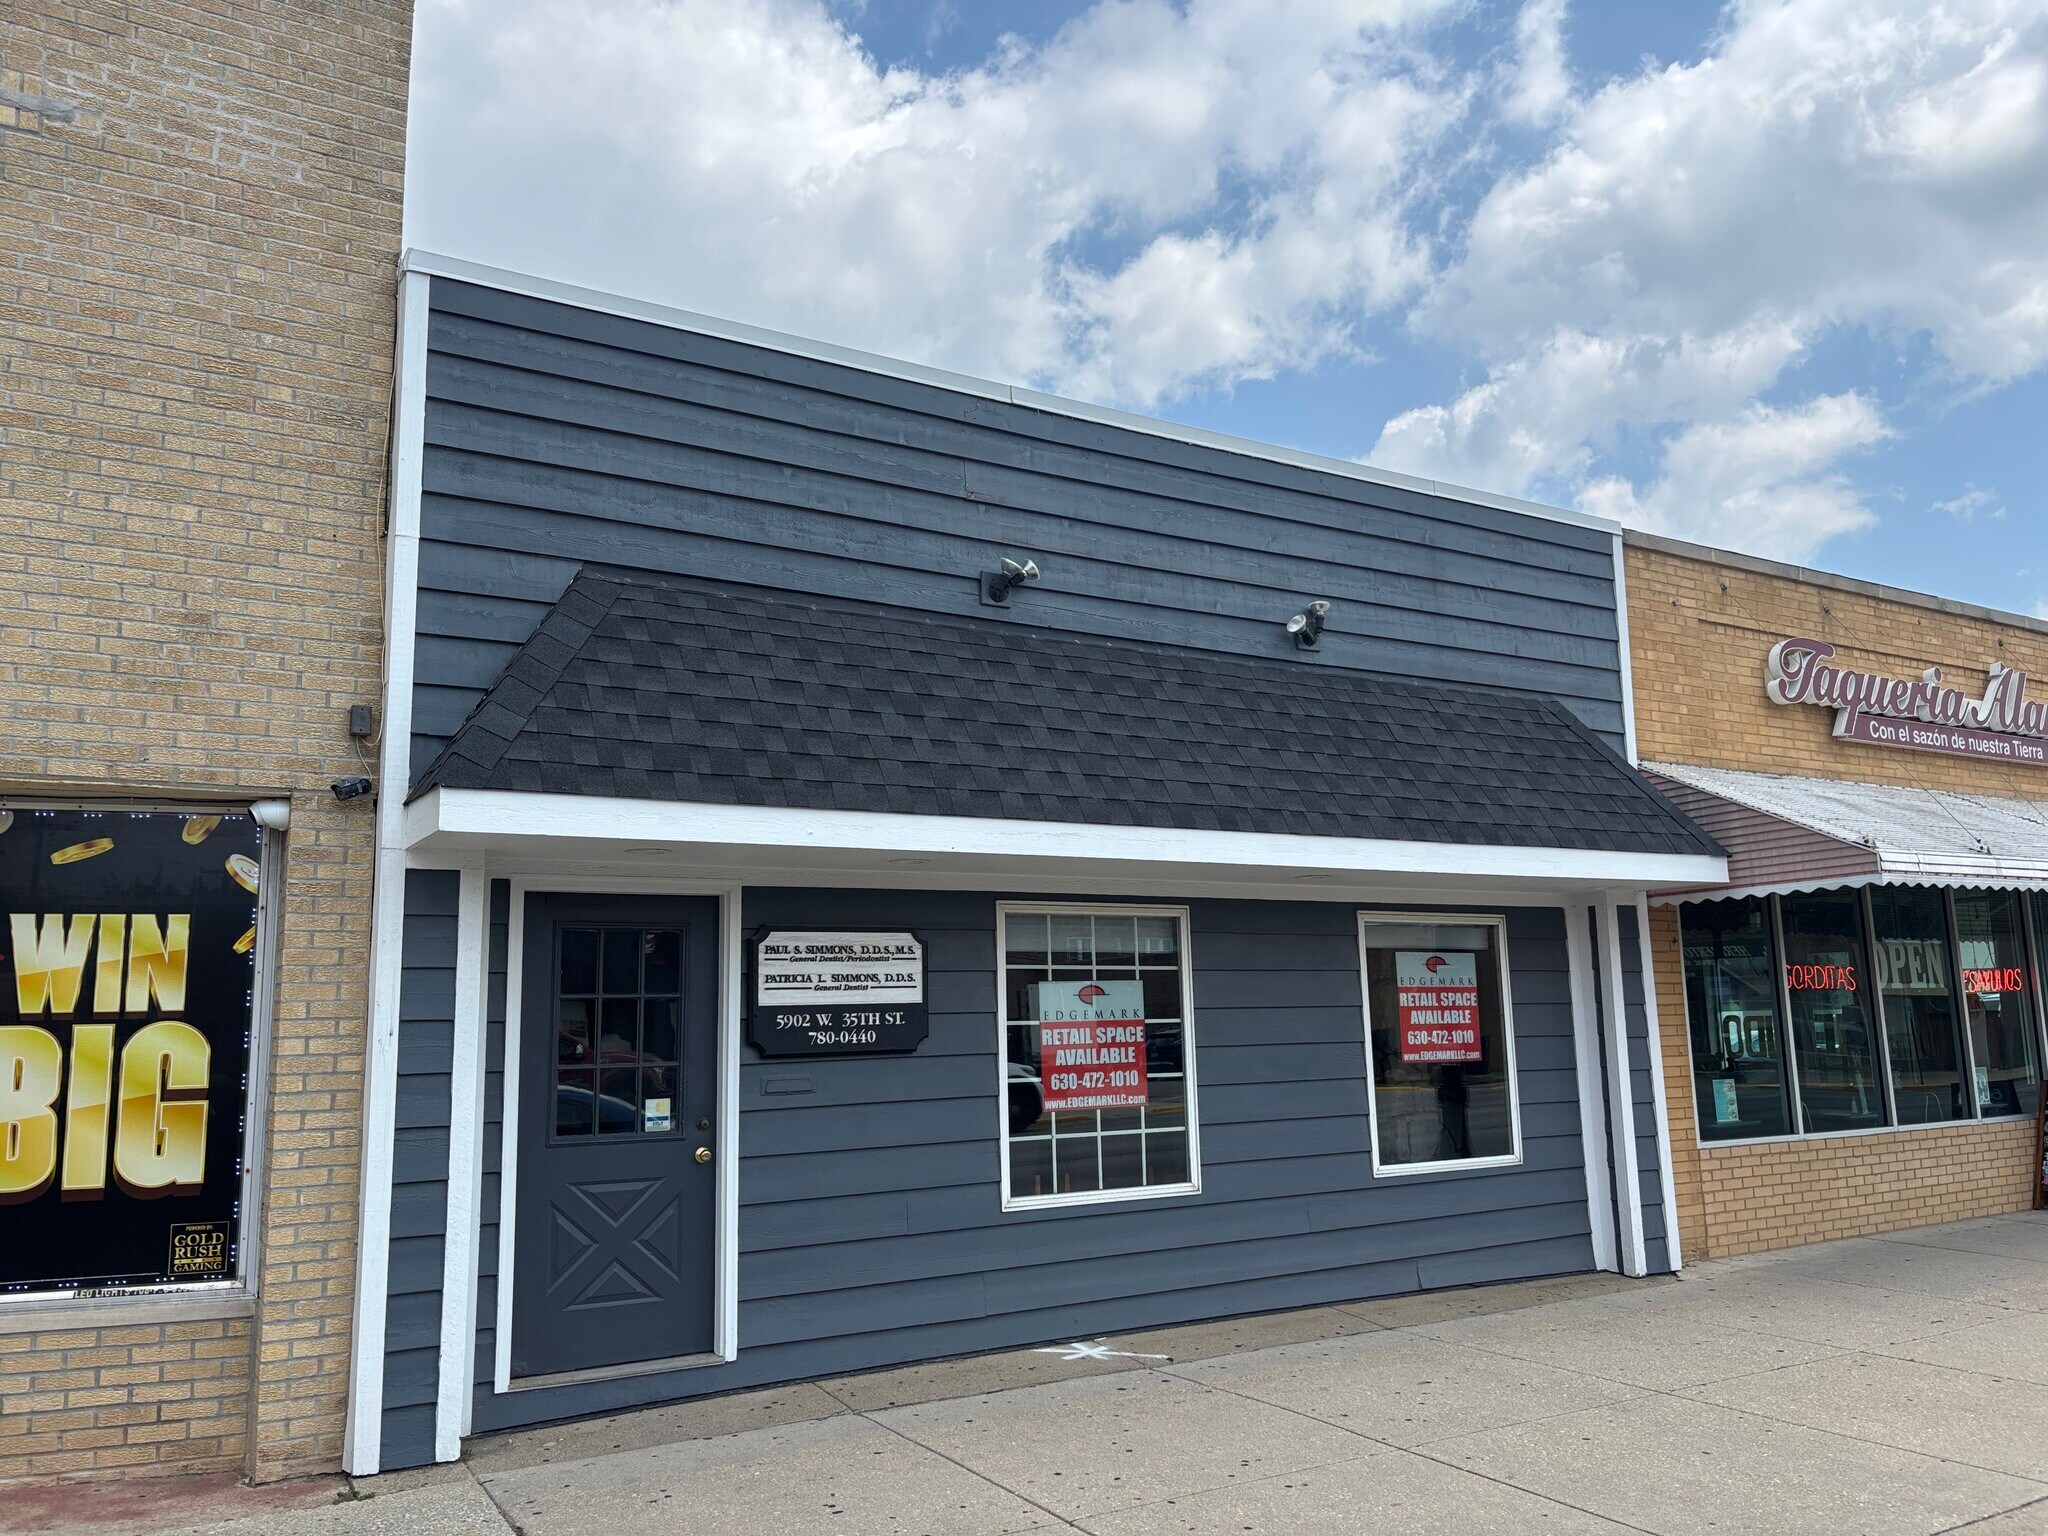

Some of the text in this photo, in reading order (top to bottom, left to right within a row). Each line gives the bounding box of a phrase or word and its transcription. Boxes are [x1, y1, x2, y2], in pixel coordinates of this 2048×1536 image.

[1768, 637, 2048, 737] Taqueria Ala
[1869, 720, 2044, 760] Con el sazón de nuestra Tierra
[764, 945, 791, 955] PAUL
[794, 945, 803, 955] S.
[805, 945, 857, 956] SIMMONS,
[9, 913, 191, 1017] WIN
[789, 955, 890, 963] General Dentist/Periodontist
[764, 973, 916, 984] PATRICIA L. SIMMONS, D.D.S.
[1400, 976, 1474, 986] EDGEMARK
[1962, 967, 2022, 993] ESAYUNOS
[814, 984, 842, 992] General
[1399, 992, 1478, 1007] RETAIL SPACE
[776, 1012, 906, 1029] 5902 W. 35TH ST.
[1043, 1008, 1141, 1020] EDGEMARK
[1410, 1009, 1472, 1025] AVAILABLE
[808, 1029, 877, 1045] 780-0440
[1041, 1026, 1145, 1046] RETAIL SPACE
[1407, 1029, 1475, 1046] 630-472-1010
[1055, 1046, 1137, 1067] AVAILABLE
[1403, 1049, 1480, 1062] www.EDGEMARKLLC.com
[1050, 1069, 1139, 1091] 630-472-1010
[0, 1020, 212, 1197] BIG
[1044, 1094, 1146, 1110] www.EDGEMARKLLC.com
[174, 1232, 225, 1247] GOLD
[174, 1244, 222, 1259] RUSH
[173, 1261, 222, 1272] GAMING
